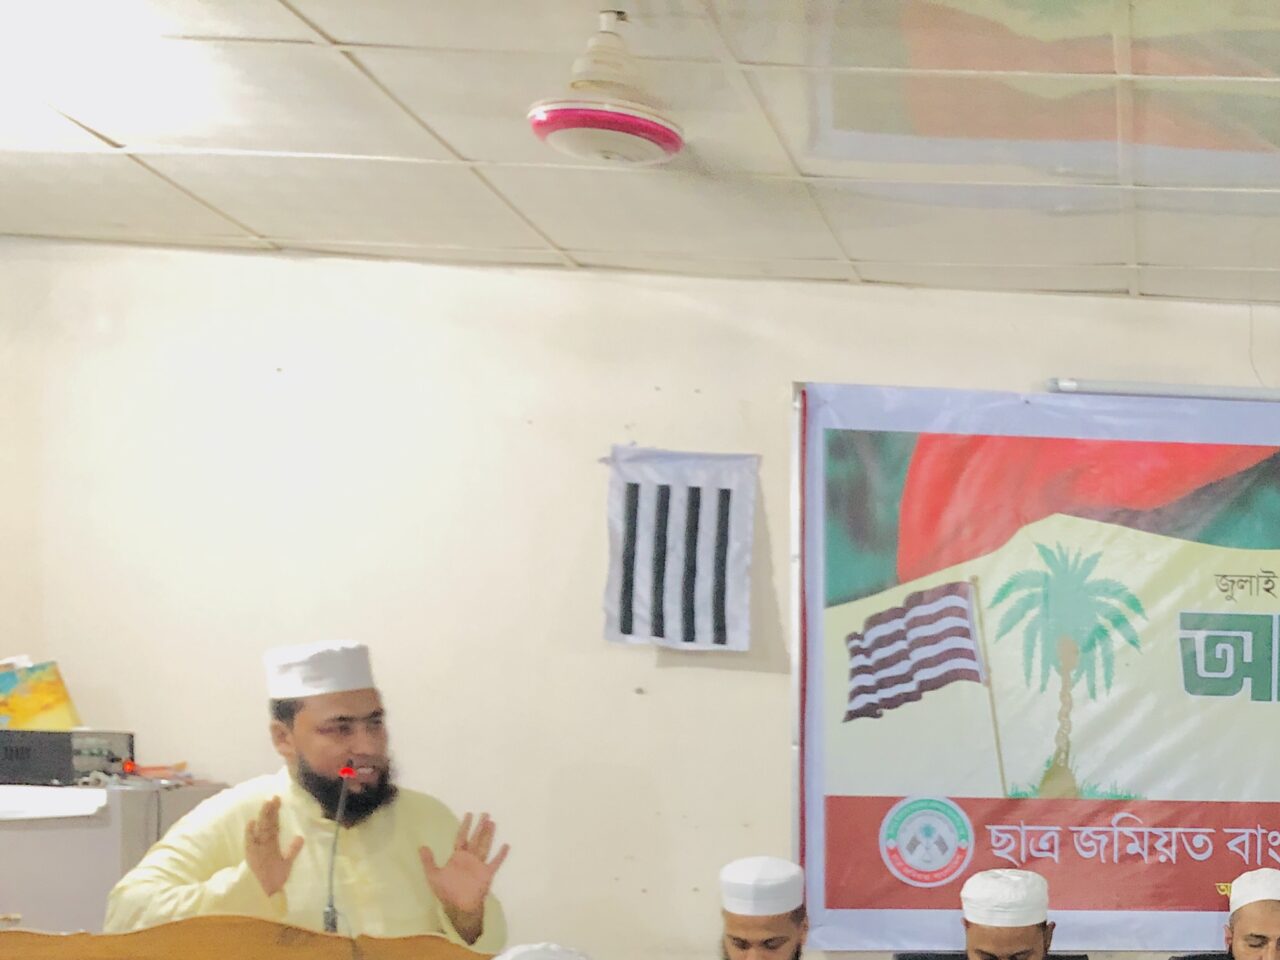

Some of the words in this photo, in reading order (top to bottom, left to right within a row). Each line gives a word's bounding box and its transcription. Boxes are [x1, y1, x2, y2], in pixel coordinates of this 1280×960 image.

[1214, 567, 1278, 602] জুলাই
[984, 820, 1063, 866] ছাত্র
[1068, 812, 1215, 864] জমিয়ত
